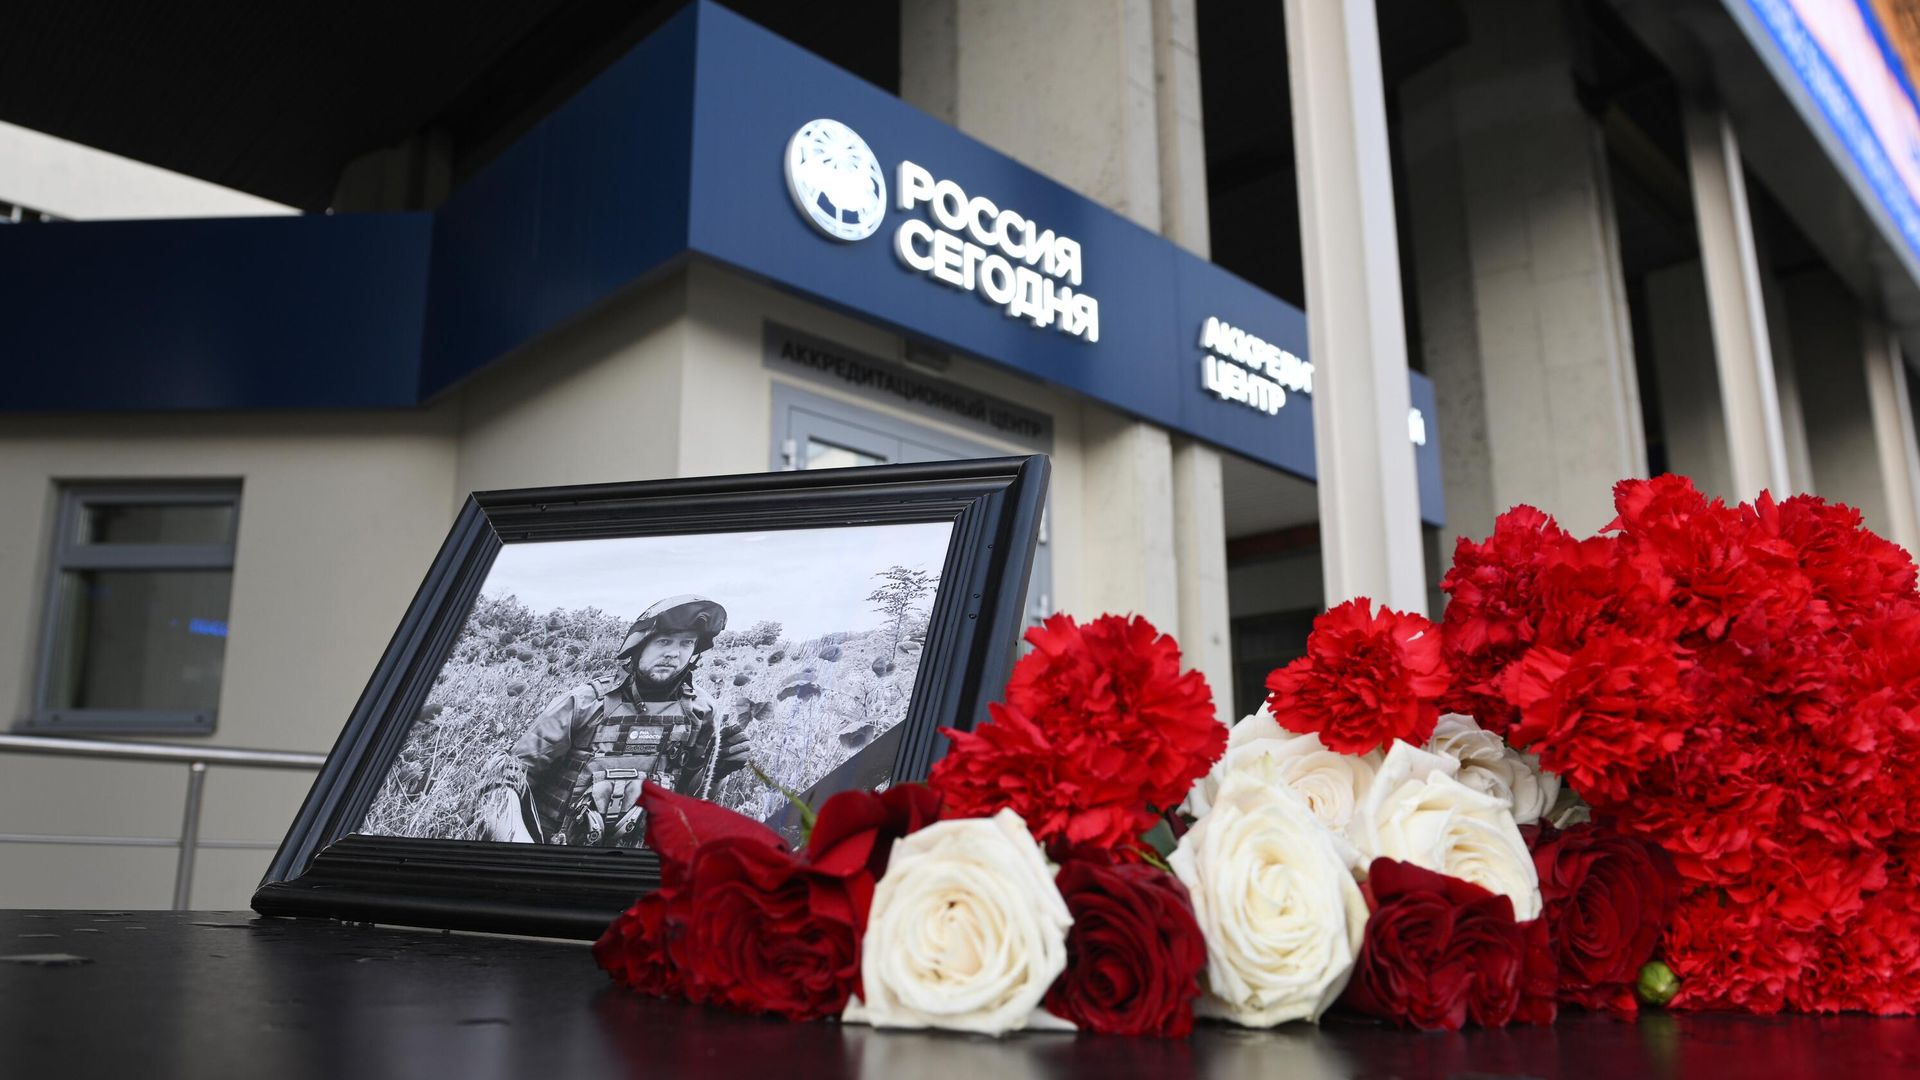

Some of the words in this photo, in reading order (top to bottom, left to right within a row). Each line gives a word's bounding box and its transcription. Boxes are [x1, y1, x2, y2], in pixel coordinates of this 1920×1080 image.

[898, 160, 1082, 286] РОССИЯ
[895, 218, 1099, 342] СЕГОДНЯ
[780, 338, 987, 422] АККРЕДИТАЦИОННЫЙ
[989, 406, 1043, 439] ЦЕНТР
[1202, 355, 1287, 416] ЦЕНТР
